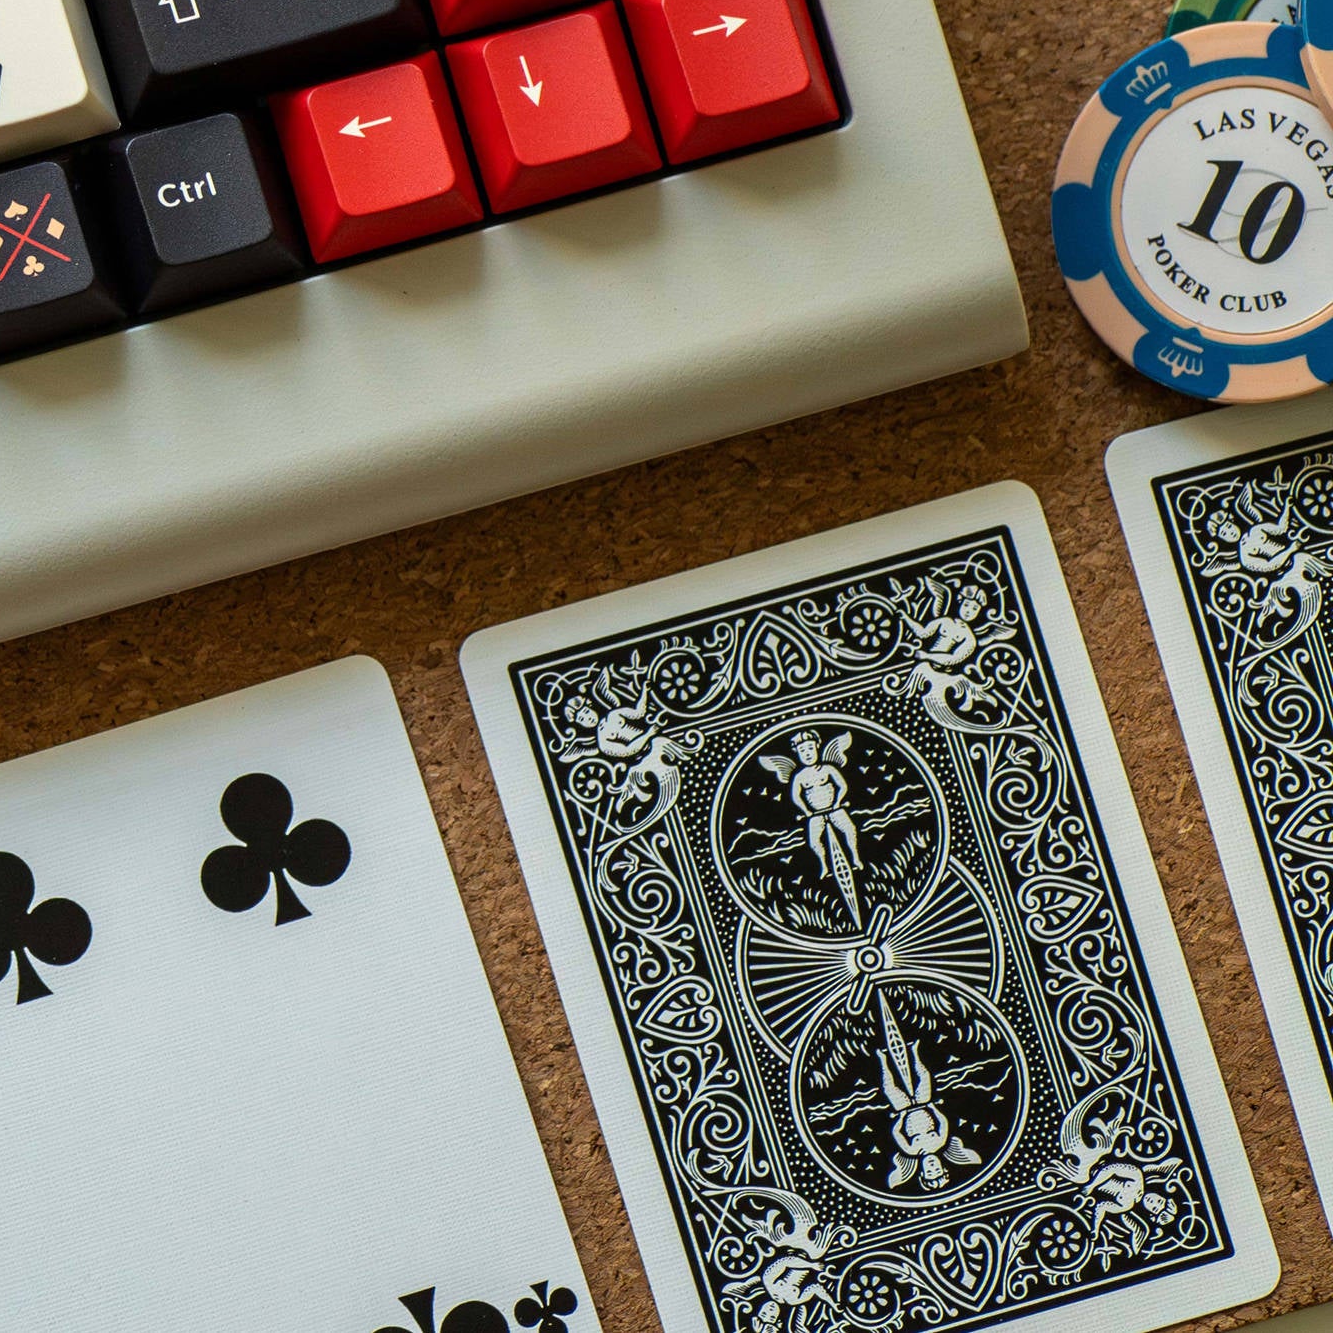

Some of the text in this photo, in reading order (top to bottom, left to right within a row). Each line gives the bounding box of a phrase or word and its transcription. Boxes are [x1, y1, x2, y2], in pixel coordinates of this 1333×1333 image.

[1194, 108, 1256, 142] LAS
[157, 172, 218, 208] Ctrl
[1176, 160, 1306, 265] 10
[1148, 233, 1288, 314] POKER CLUB
